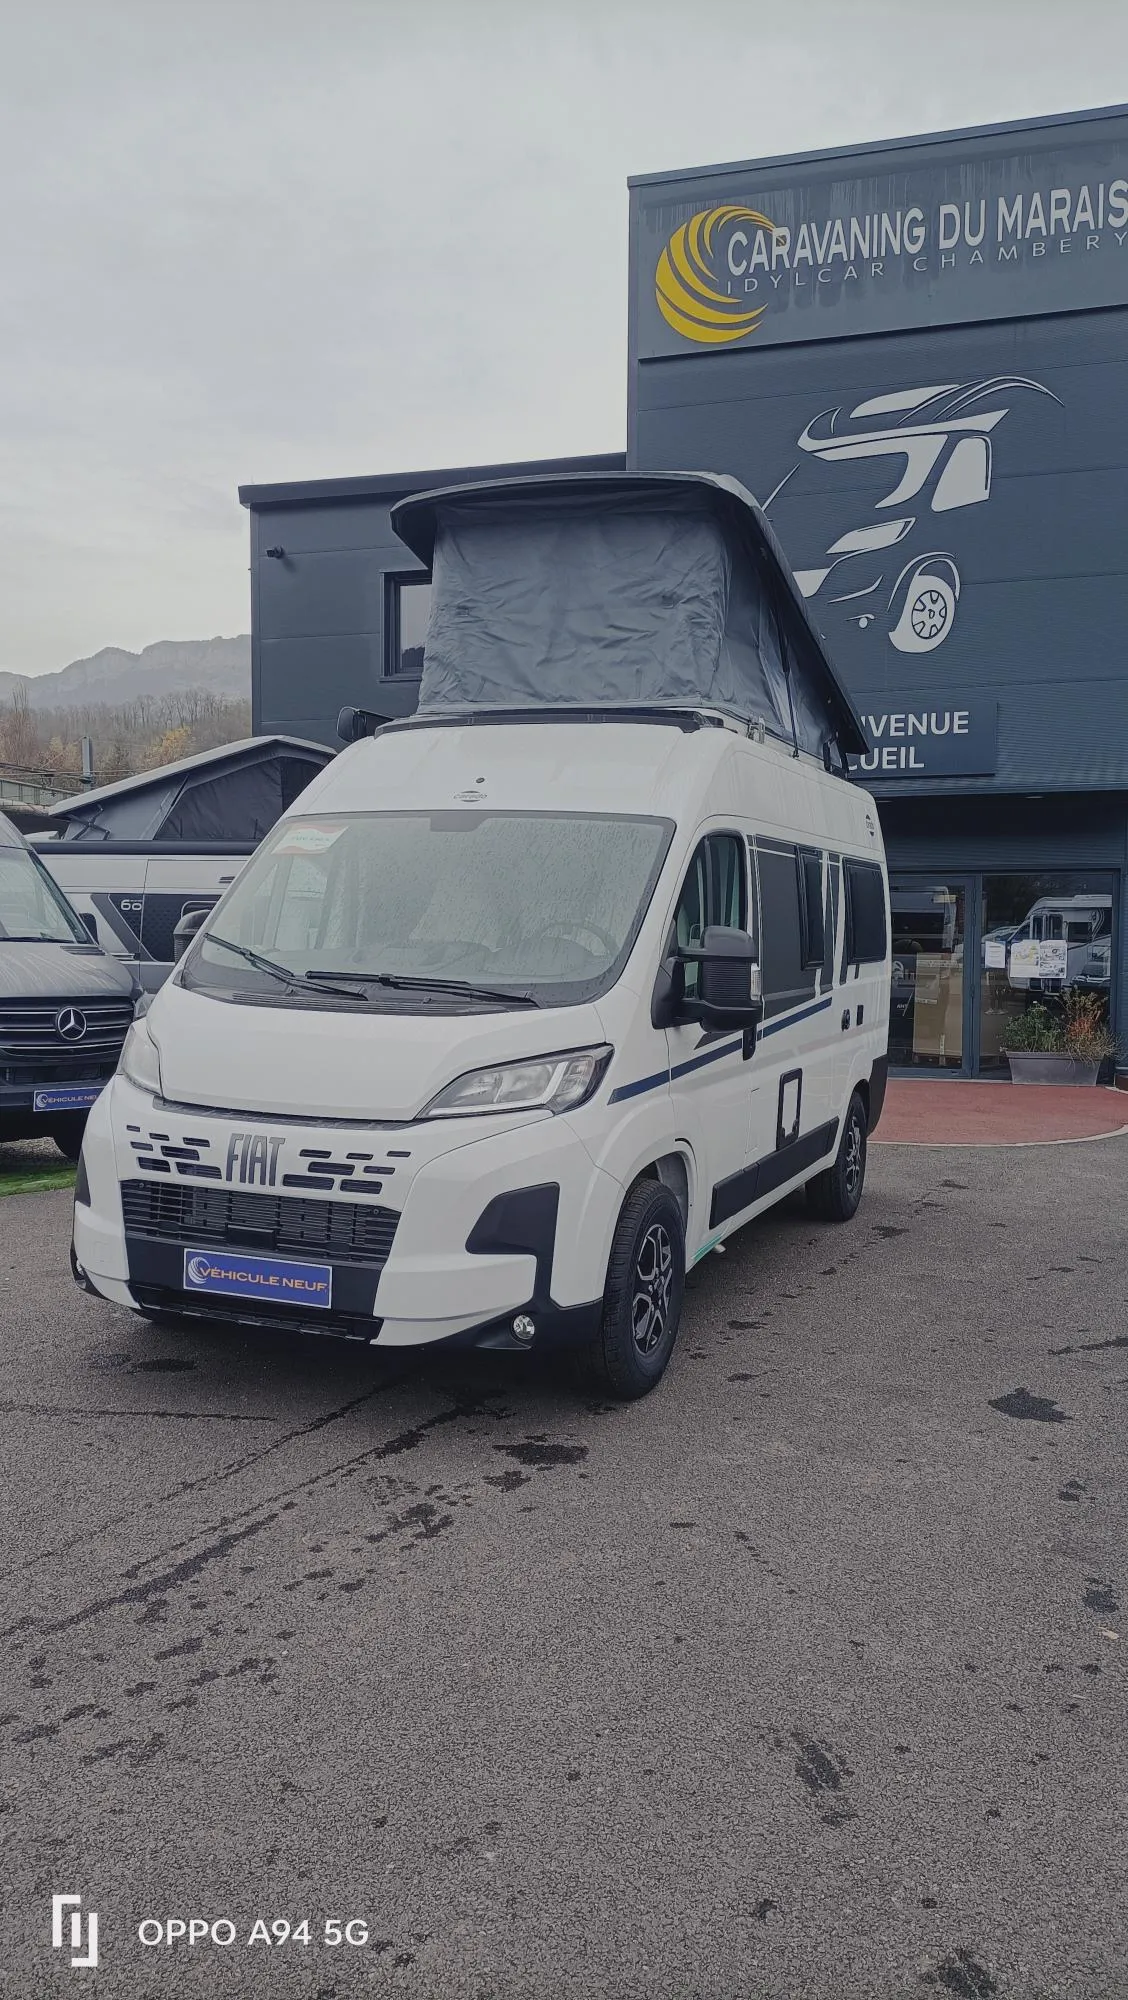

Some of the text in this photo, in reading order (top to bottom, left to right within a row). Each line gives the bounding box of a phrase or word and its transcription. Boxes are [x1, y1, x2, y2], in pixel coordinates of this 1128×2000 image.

[727, 179, 1128, 276] CARAVANING DU MARAIS
[727, 231, 1128, 294] IDYLCAR CHAMBERY
[861, 711, 969, 737] VENUE
[226, 1133, 286, 1187] FIAT
[200, 1266, 328, 1292] VÉHICULE NEUF
